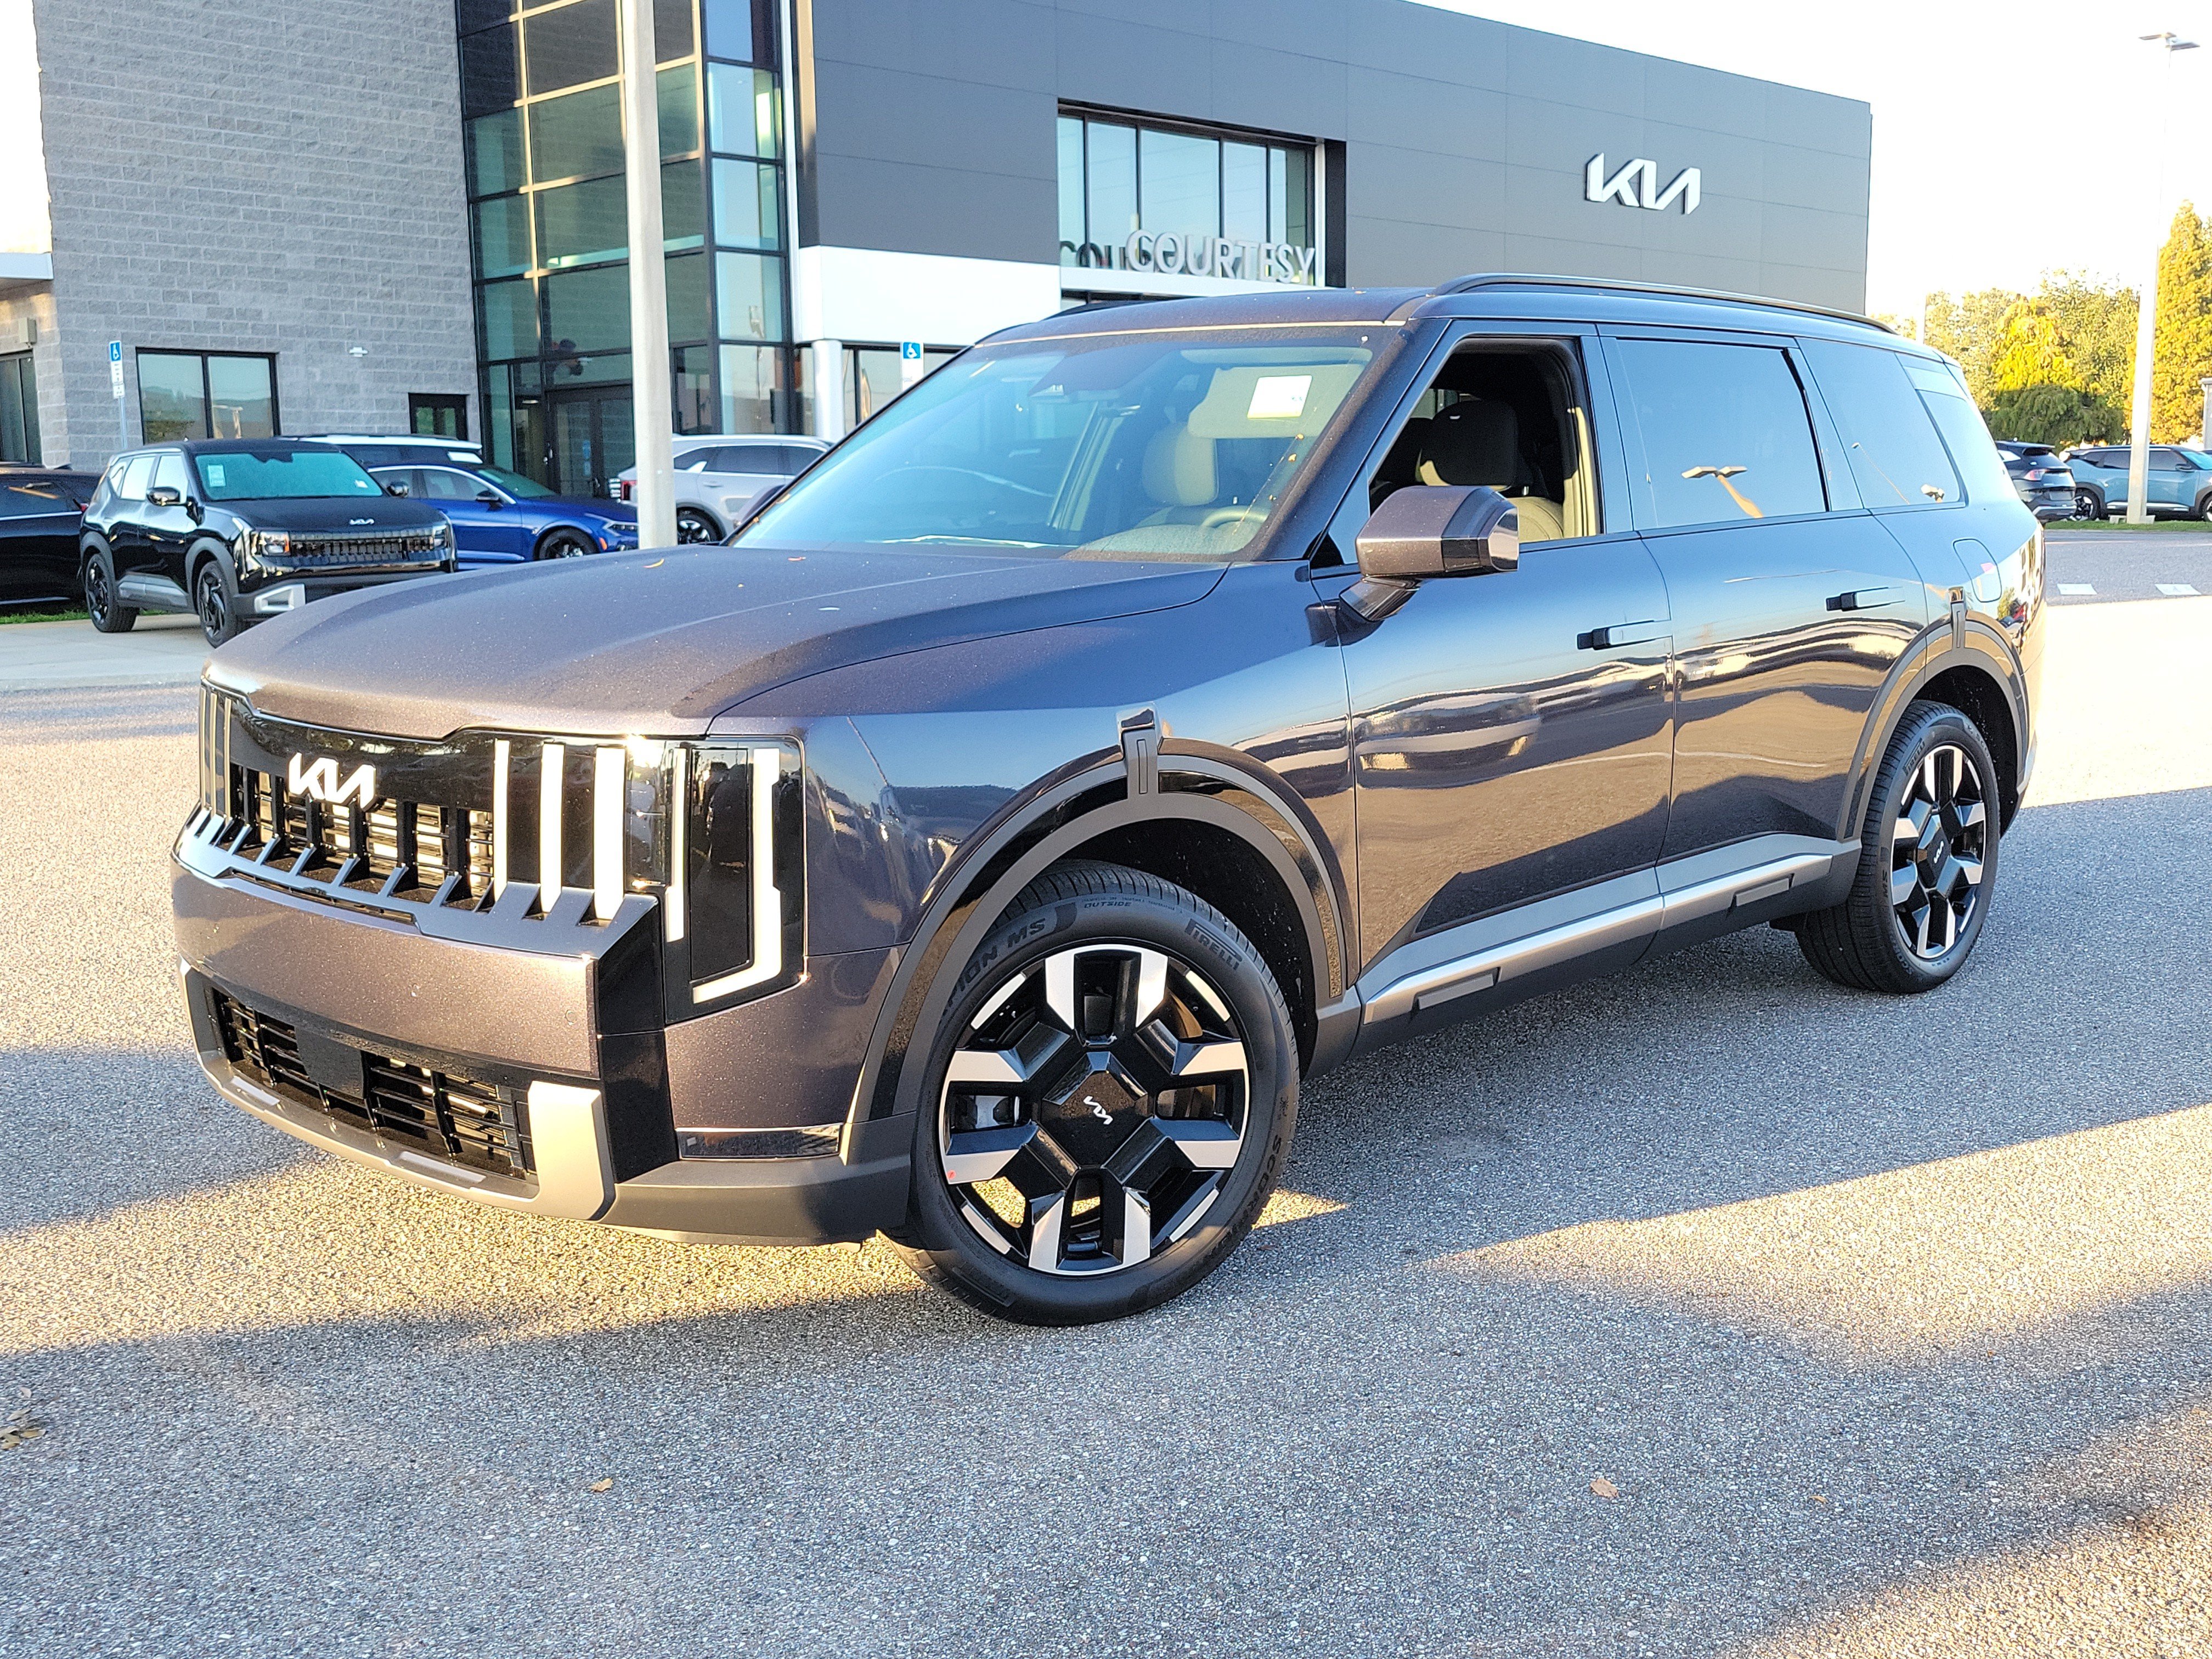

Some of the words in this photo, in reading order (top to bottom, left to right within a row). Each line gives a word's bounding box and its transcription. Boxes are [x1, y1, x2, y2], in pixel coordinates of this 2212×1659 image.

[1585, 152, 1701, 215] KIA
[1126, 229, 1315, 285] COURTESY
[289, 752, 376, 810] KIA
[1007, 918, 1046, 948] MS
[1185, 918, 1243, 970] PIRELLI
